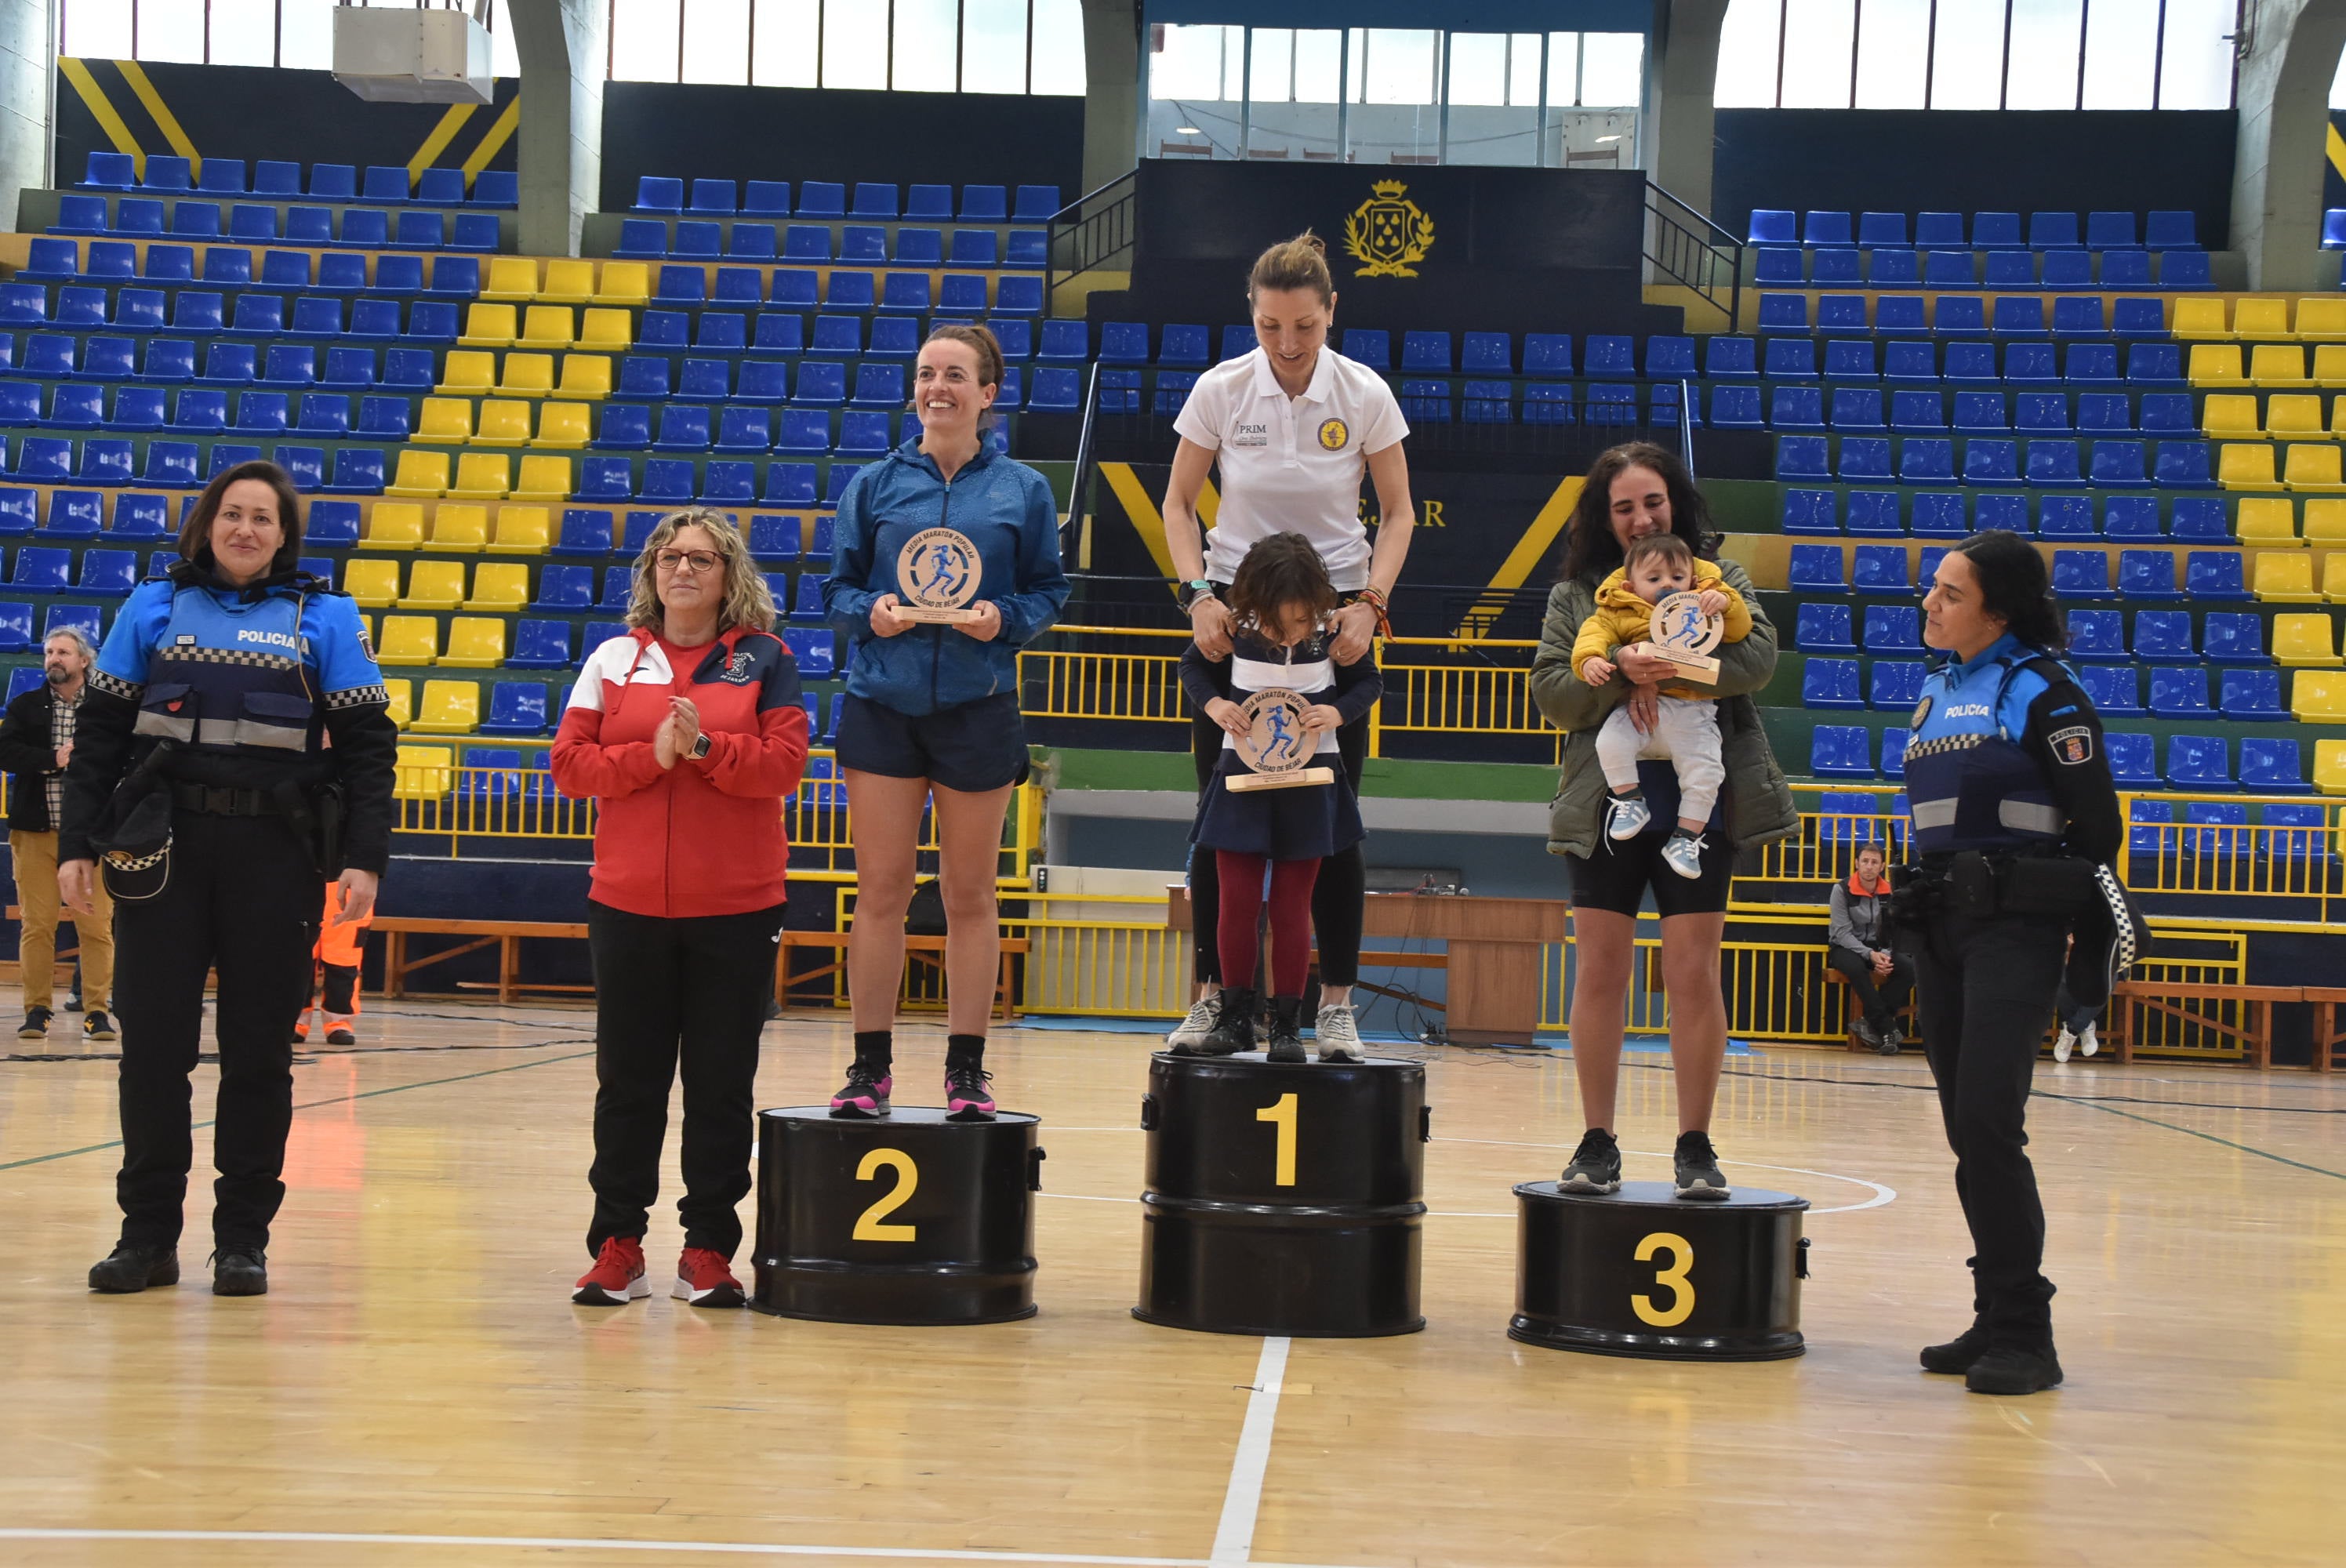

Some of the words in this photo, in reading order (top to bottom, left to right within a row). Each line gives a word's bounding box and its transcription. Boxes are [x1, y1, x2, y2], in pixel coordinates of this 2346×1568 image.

[1240, 424, 1266, 434] PRIM
[906, 536, 923, 554] MEDIA
[953, 535, 975, 559] POPULAR
[914, 595, 935, 608] CIUDAD
[1662, 597, 1677, 608] MEDIA
[238, 630, 296, 649] POLICIA
[1255, 761, 1276, 772] CIUDAD
[1256, 1093, 1298, 1186] 1
[852, 1148, 919, 1242] 2
[1630, 1232, 1696, 1327] 3
